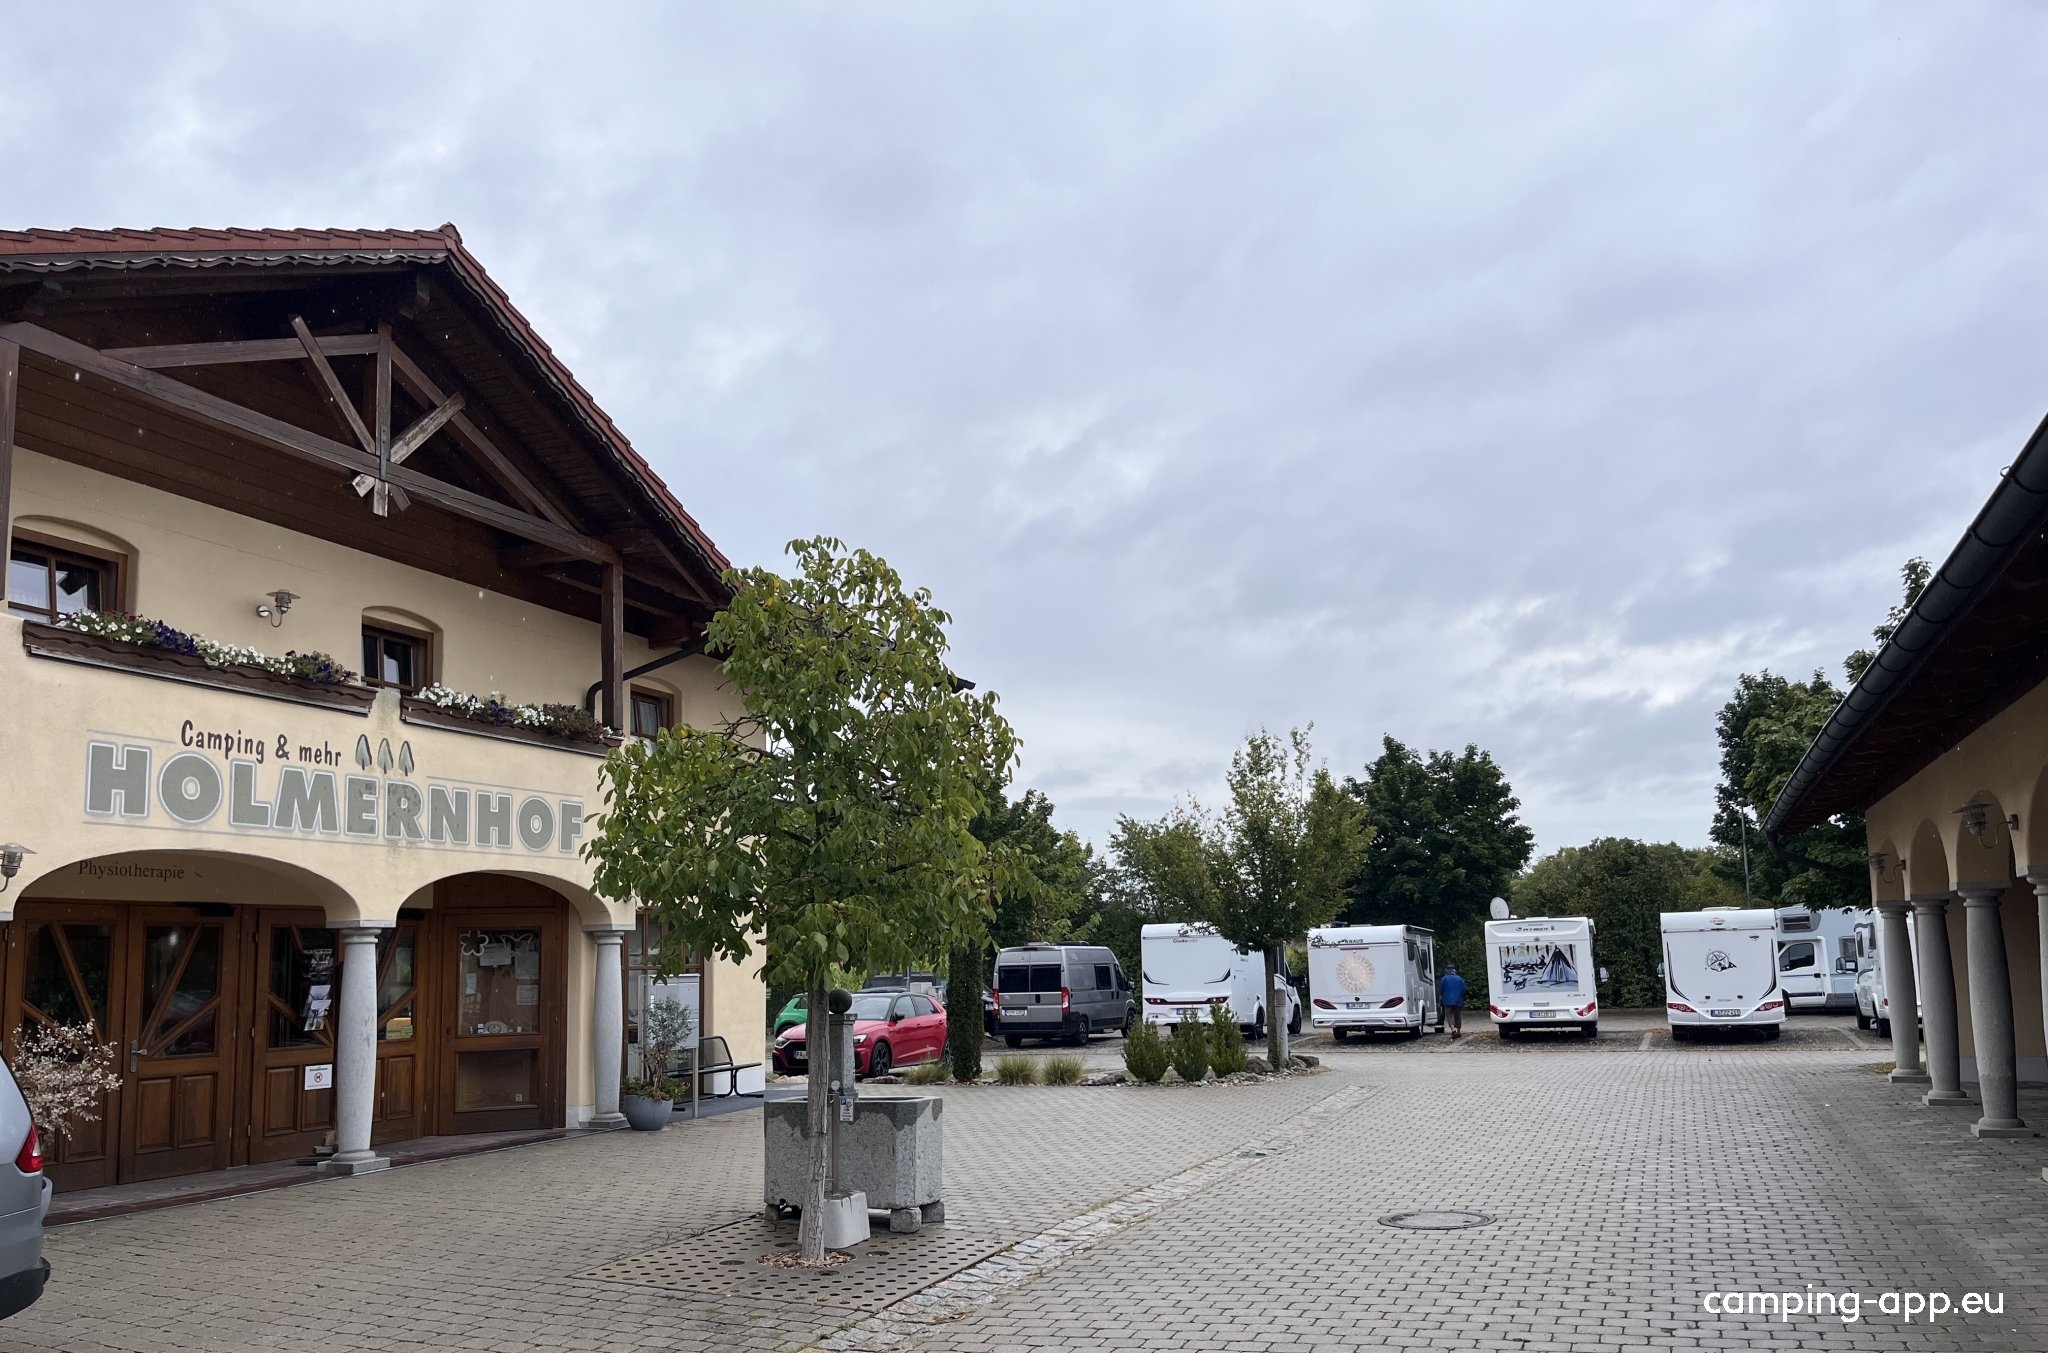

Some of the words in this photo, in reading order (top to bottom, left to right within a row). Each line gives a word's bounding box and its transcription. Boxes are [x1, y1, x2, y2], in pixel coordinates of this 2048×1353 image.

[181, 719, 265, 764] Camping
[275, 733, 290, 759] &
[299, 741, 342, 767] mehr
[84, 739, 585, 854] HOLMERNHOF
[79, 859, 185, 882] Physiotherapie
